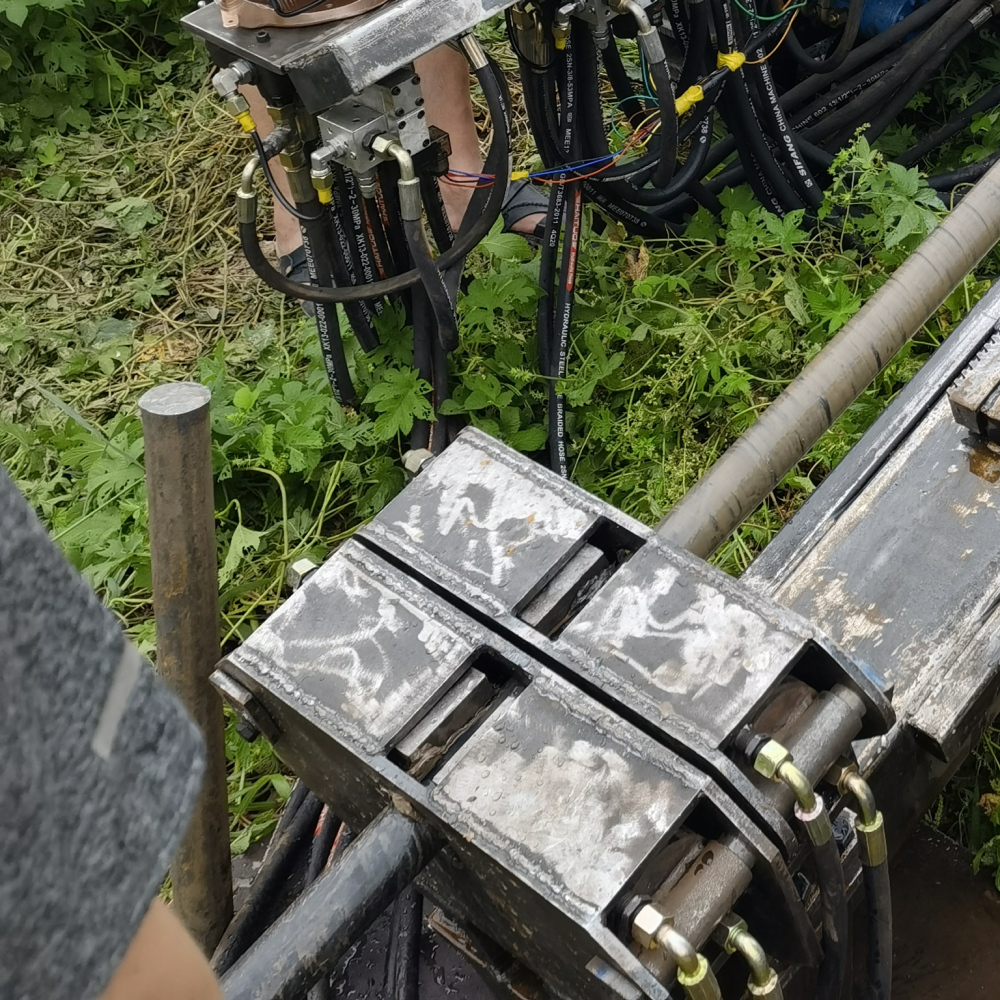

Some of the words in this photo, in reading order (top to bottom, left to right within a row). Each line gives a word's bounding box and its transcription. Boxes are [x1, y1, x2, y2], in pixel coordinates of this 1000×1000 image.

[758, 62, 778, 106] MACHINE
[772, 106, 789, 133] CHINA
[782, 135, 808, 177] SIFANG
[607, 202, 641, 225] MEE070738
[561, 302, 571, 348] HYDRAULIC
[558, 350, 566, 376] STEEL
[558, 441, 566, 462] HOSE
